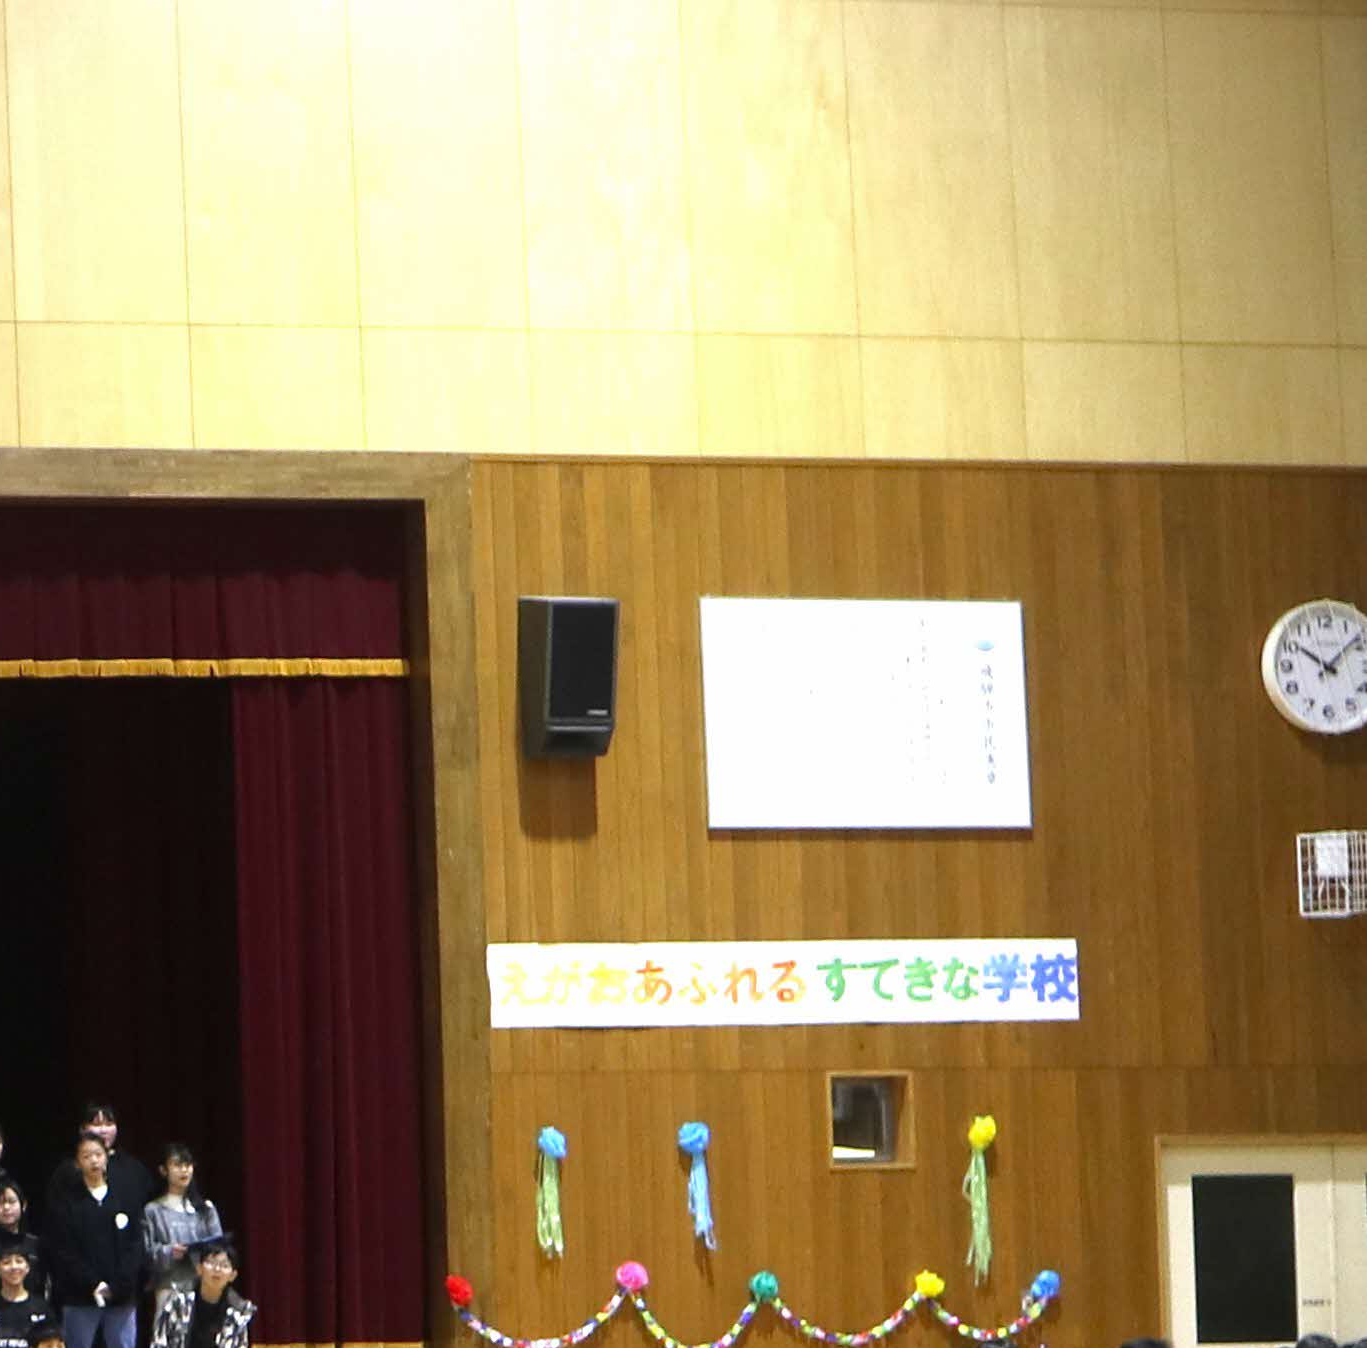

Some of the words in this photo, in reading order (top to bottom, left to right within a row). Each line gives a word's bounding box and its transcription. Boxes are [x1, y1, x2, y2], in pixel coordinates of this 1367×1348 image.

[1316, 615, 1332, 629] 12
[1297, 622, 1311, 637] 11
[1283, 640, 1300, 654] 10
[500, 960, 807, 1006] えがおあふれる
[816, 953, 1077, 1002] すてきな学校
